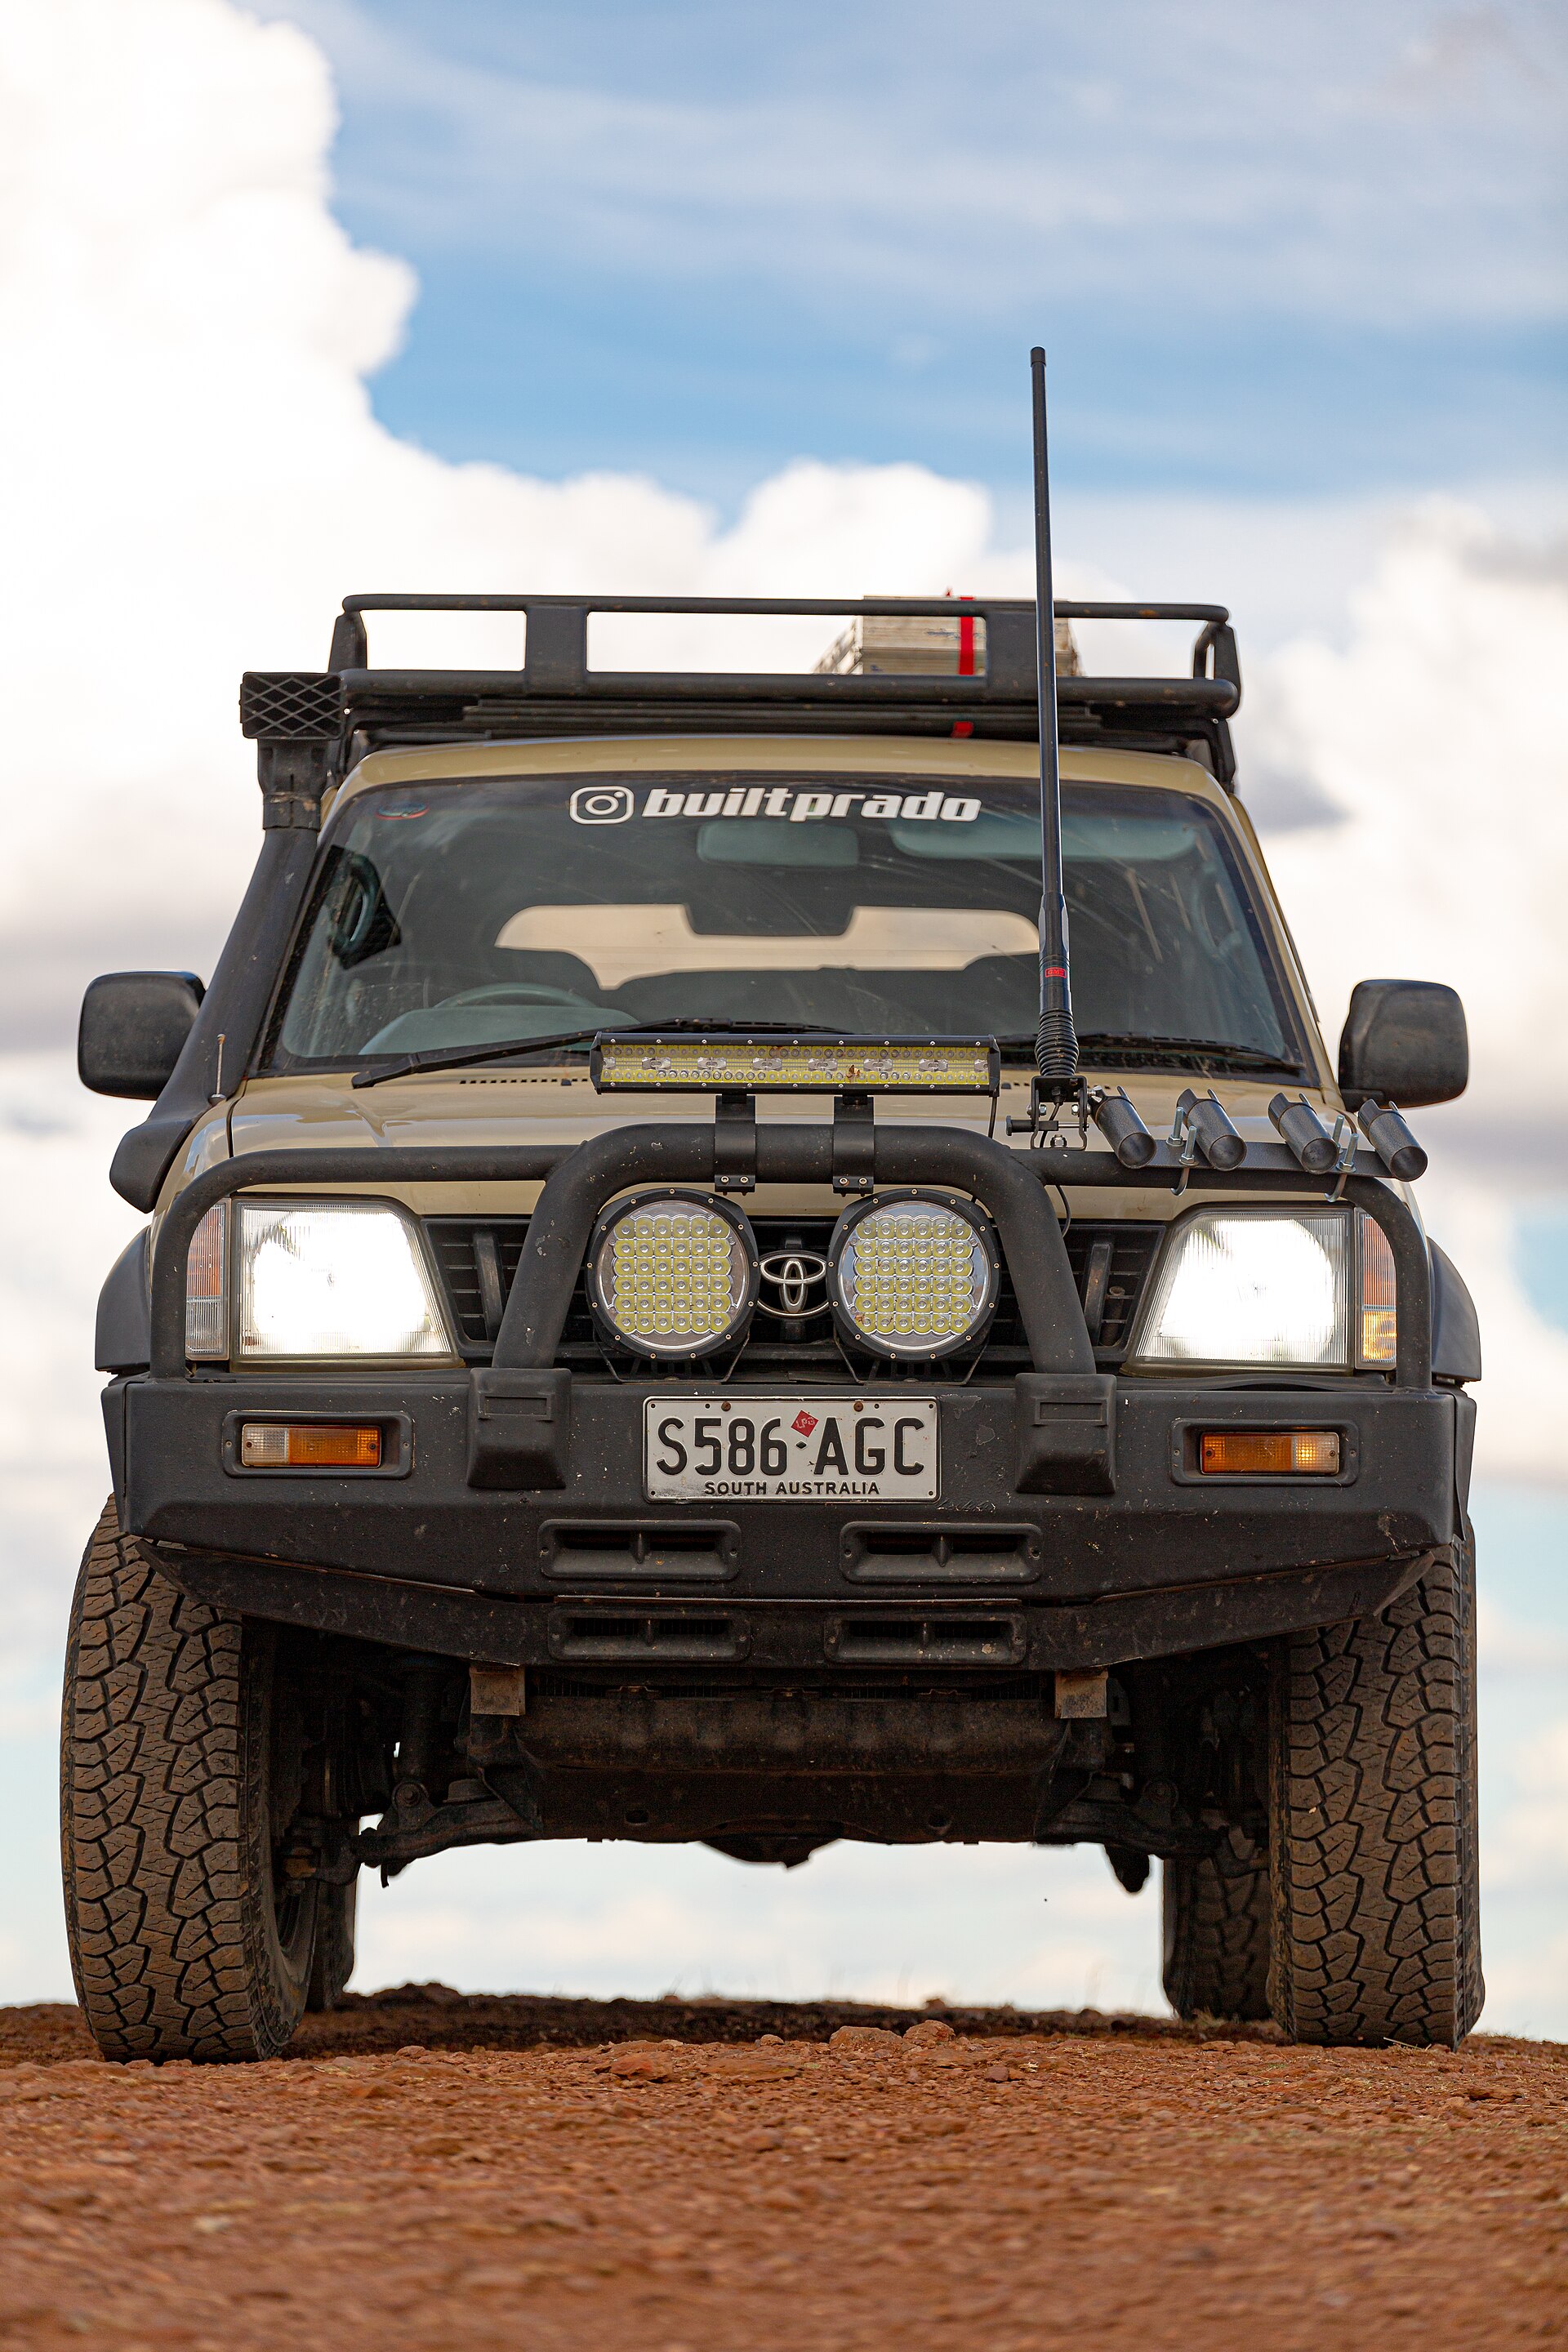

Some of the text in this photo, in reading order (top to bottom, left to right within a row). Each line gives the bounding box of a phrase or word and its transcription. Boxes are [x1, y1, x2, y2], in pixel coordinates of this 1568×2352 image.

[642, 787, 982, 822] builtprado
[704, 1481, 880, 1494] SOUTH AUSTRALIA
